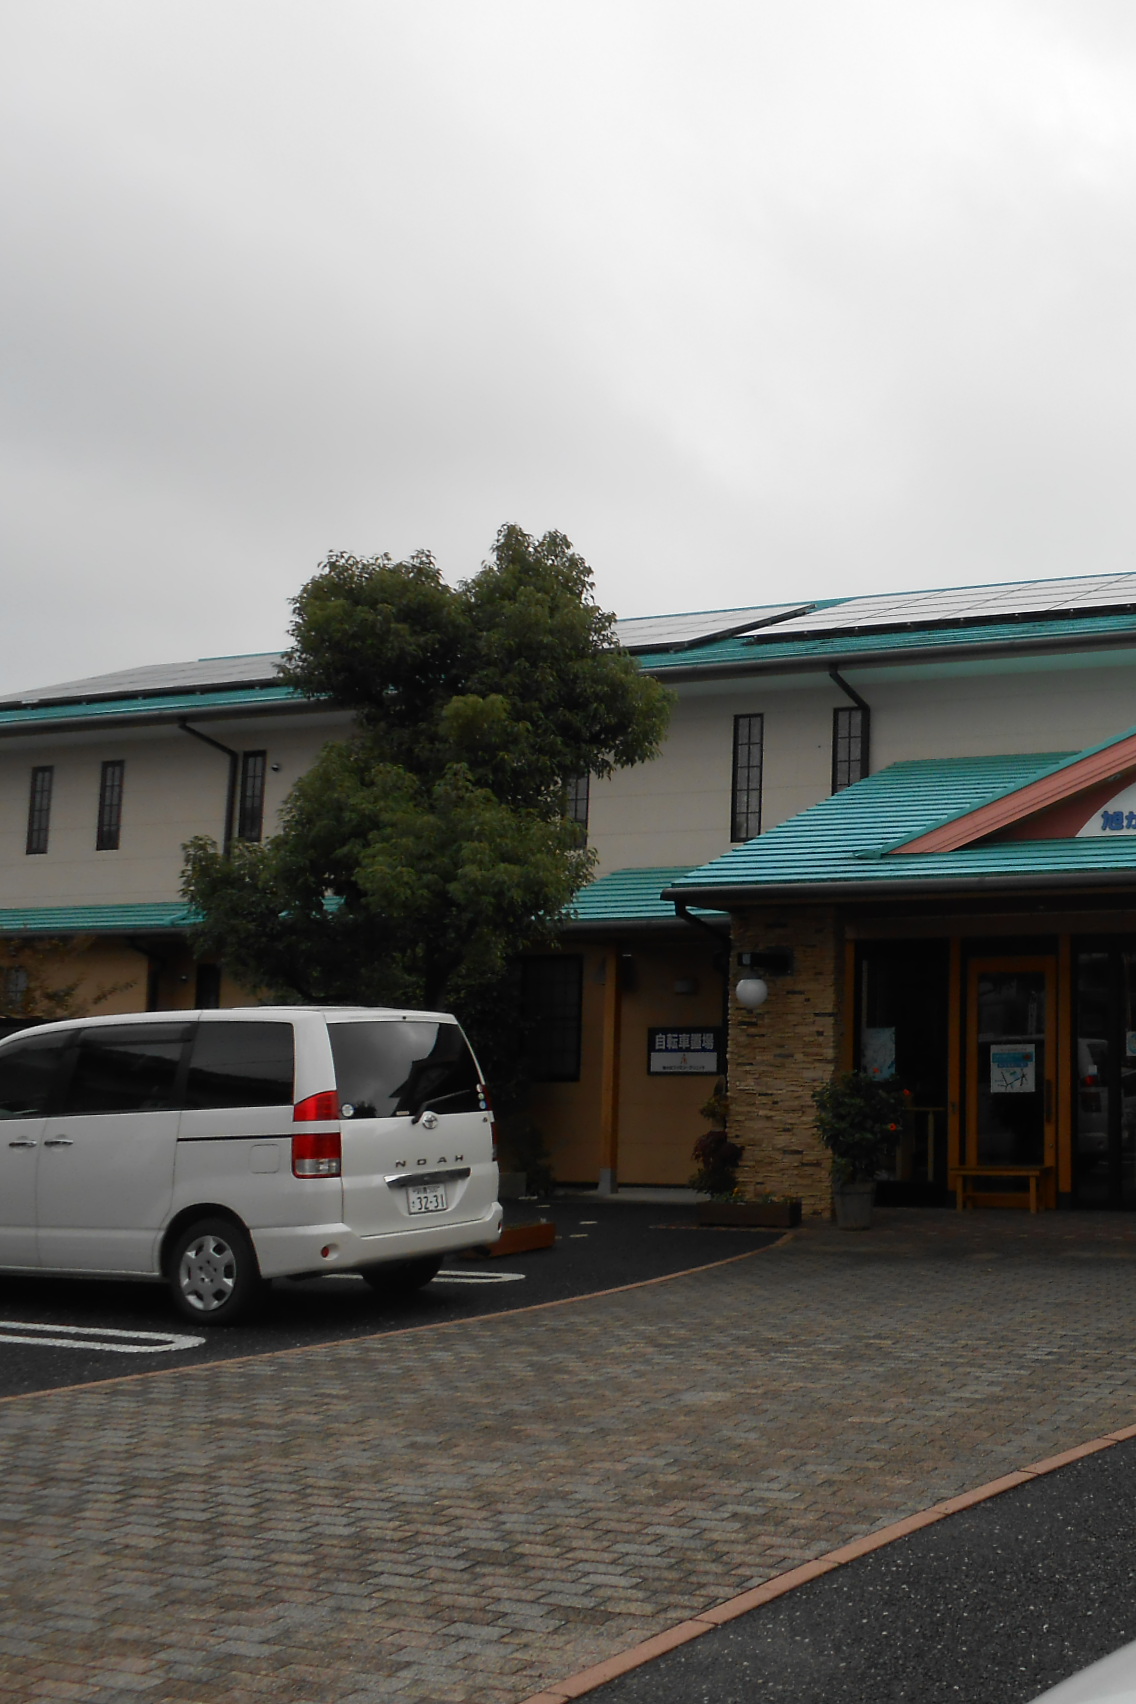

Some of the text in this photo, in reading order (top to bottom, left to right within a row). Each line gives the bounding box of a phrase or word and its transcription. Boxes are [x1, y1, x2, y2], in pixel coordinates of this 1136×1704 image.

[655, 1033, 714, 1050] 自転車置場
[395, 1155, 464, 1168] NOAH
[417, 1194, 445, 1211] 32-31
